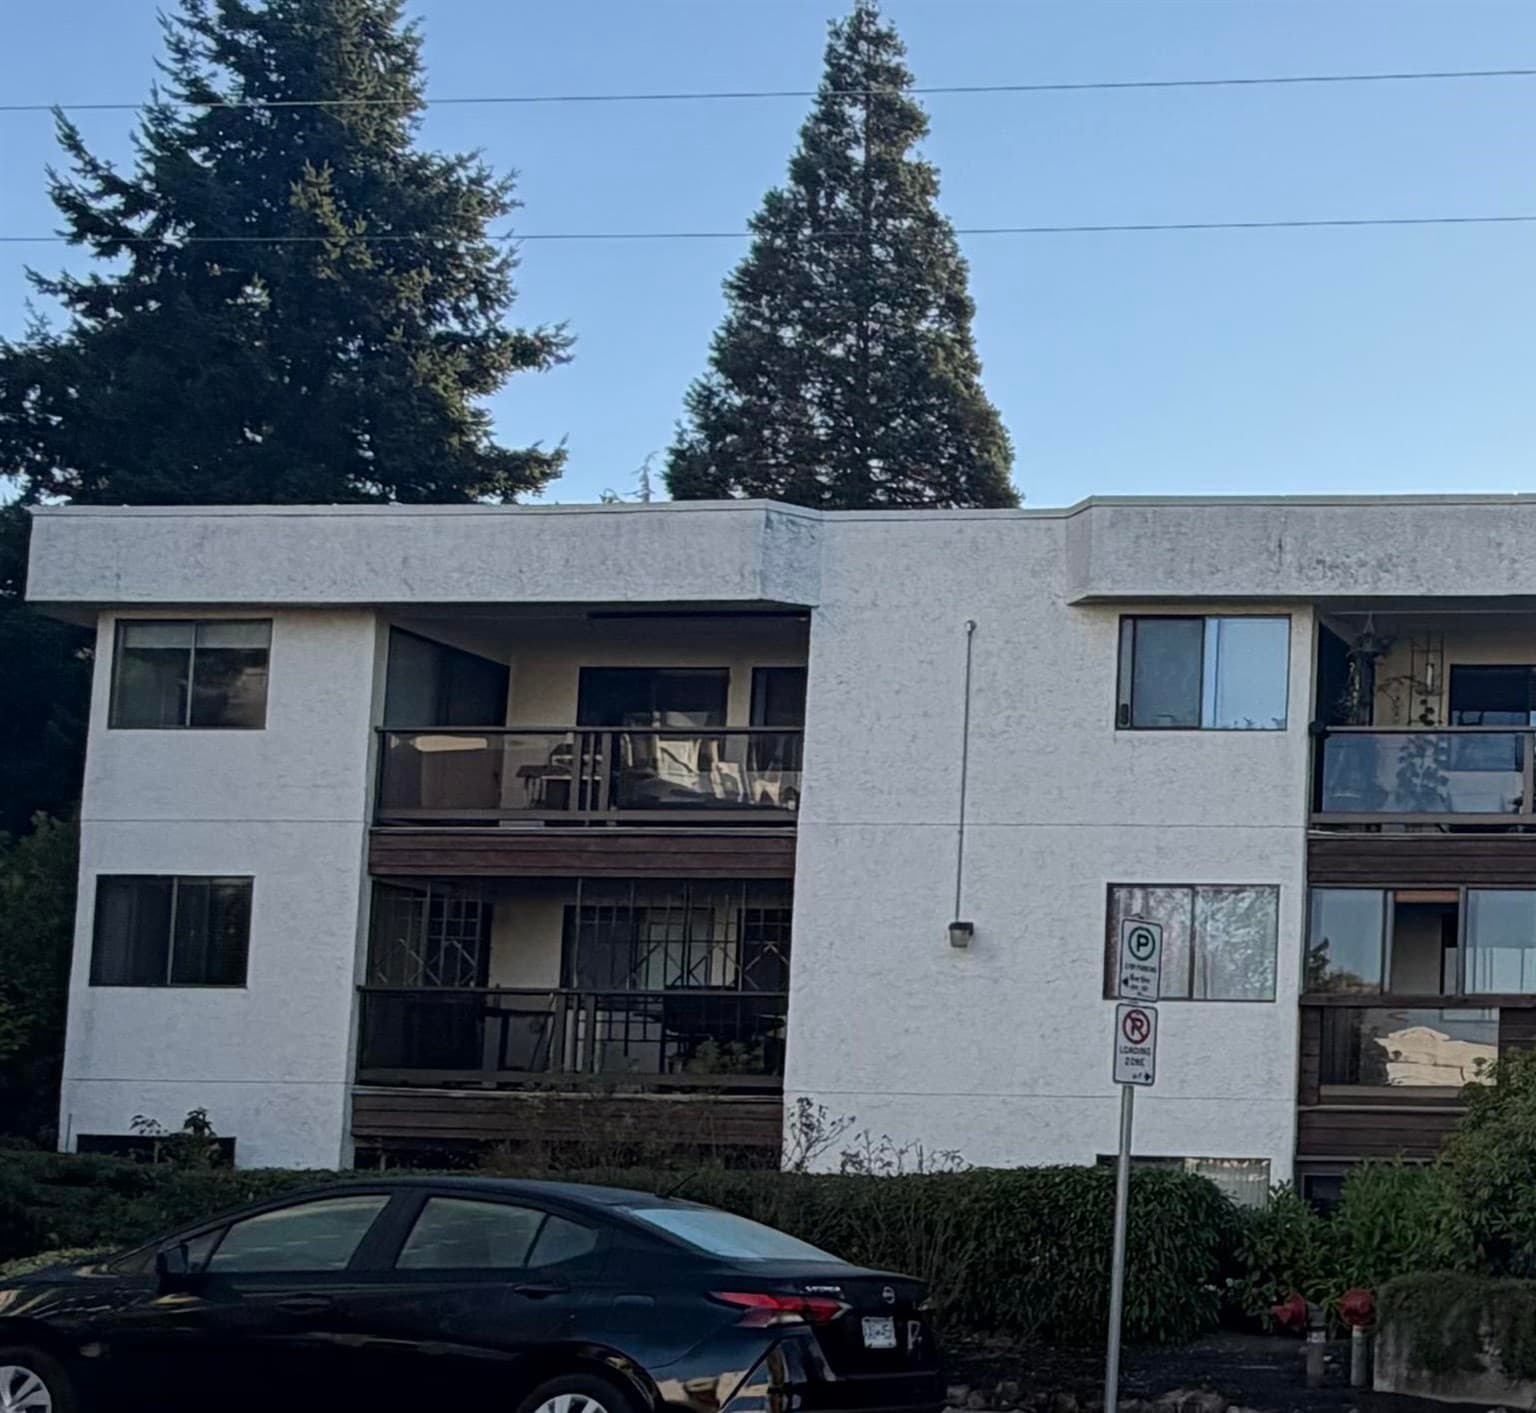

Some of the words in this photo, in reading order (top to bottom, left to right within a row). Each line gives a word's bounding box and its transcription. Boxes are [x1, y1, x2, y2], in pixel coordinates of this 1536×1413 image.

[1136, 933, 1149, 952] P
[1119, 1046, 1151, 1056] LOADING
[1124, 1057, 1145, 1066] ZONE
